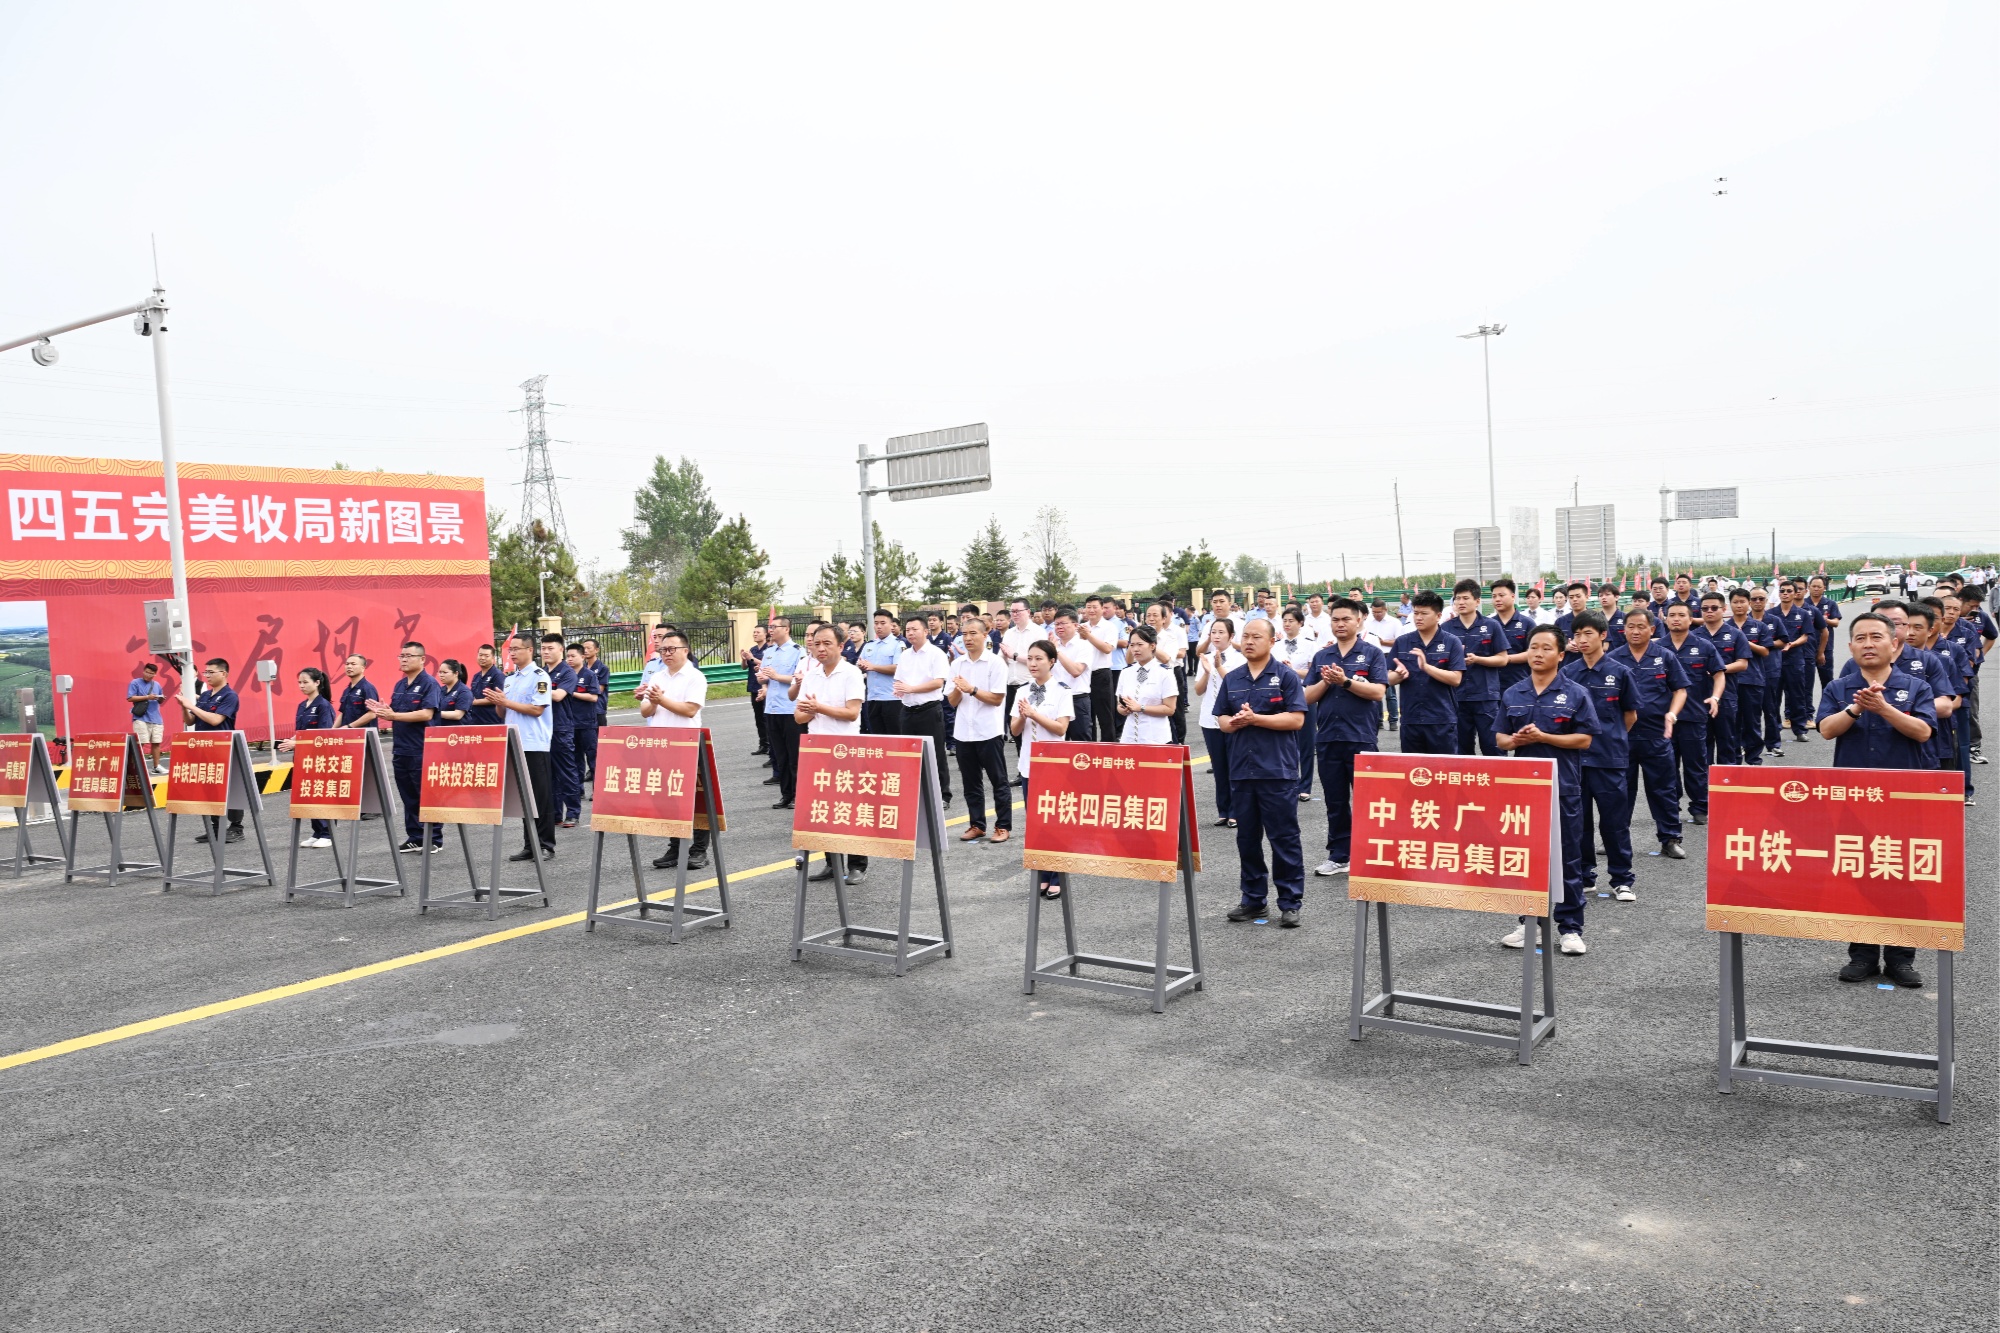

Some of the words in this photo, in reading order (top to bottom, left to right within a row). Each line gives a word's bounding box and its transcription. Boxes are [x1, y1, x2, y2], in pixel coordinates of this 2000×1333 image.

[8, 488, 465, 545] 四五完美收局新图景
[459, 735, 482, 744] 中国中铁
[639, 738, 667, 748] 中国中铁
[849, 747, 883, 758] 中国中铁
[76, 756, 119, 771] 中铁广州
[173, 762, 224, 784] 中铁四局集团
[303, 755, 352, 773] 中铁交通
[1093, 757, 1135, 769] 中国中铁
[428, 762, 498, 787] 中铁投资集团
[604, 766, 684, 796] 监理单位
[814, 768, 900, 796] 中铁交通
[1435, 771, 1490, 786] 中国中铁
[74, 777, 117, 793] 工程局集团
[300, 780, 351, 797] 投资集团
[1813, 785, 1883, 802] 中国中铁
[811, 800, 898, 829] 投资集团
[1038, 790, 1167, 831] 中铁四局集团
[1369, 798, 1530, 835] 中铁广州
[1366, 838, 1530, 878] 工程局集团
[1726, 828, 1942, 882] 中铁一局集团
